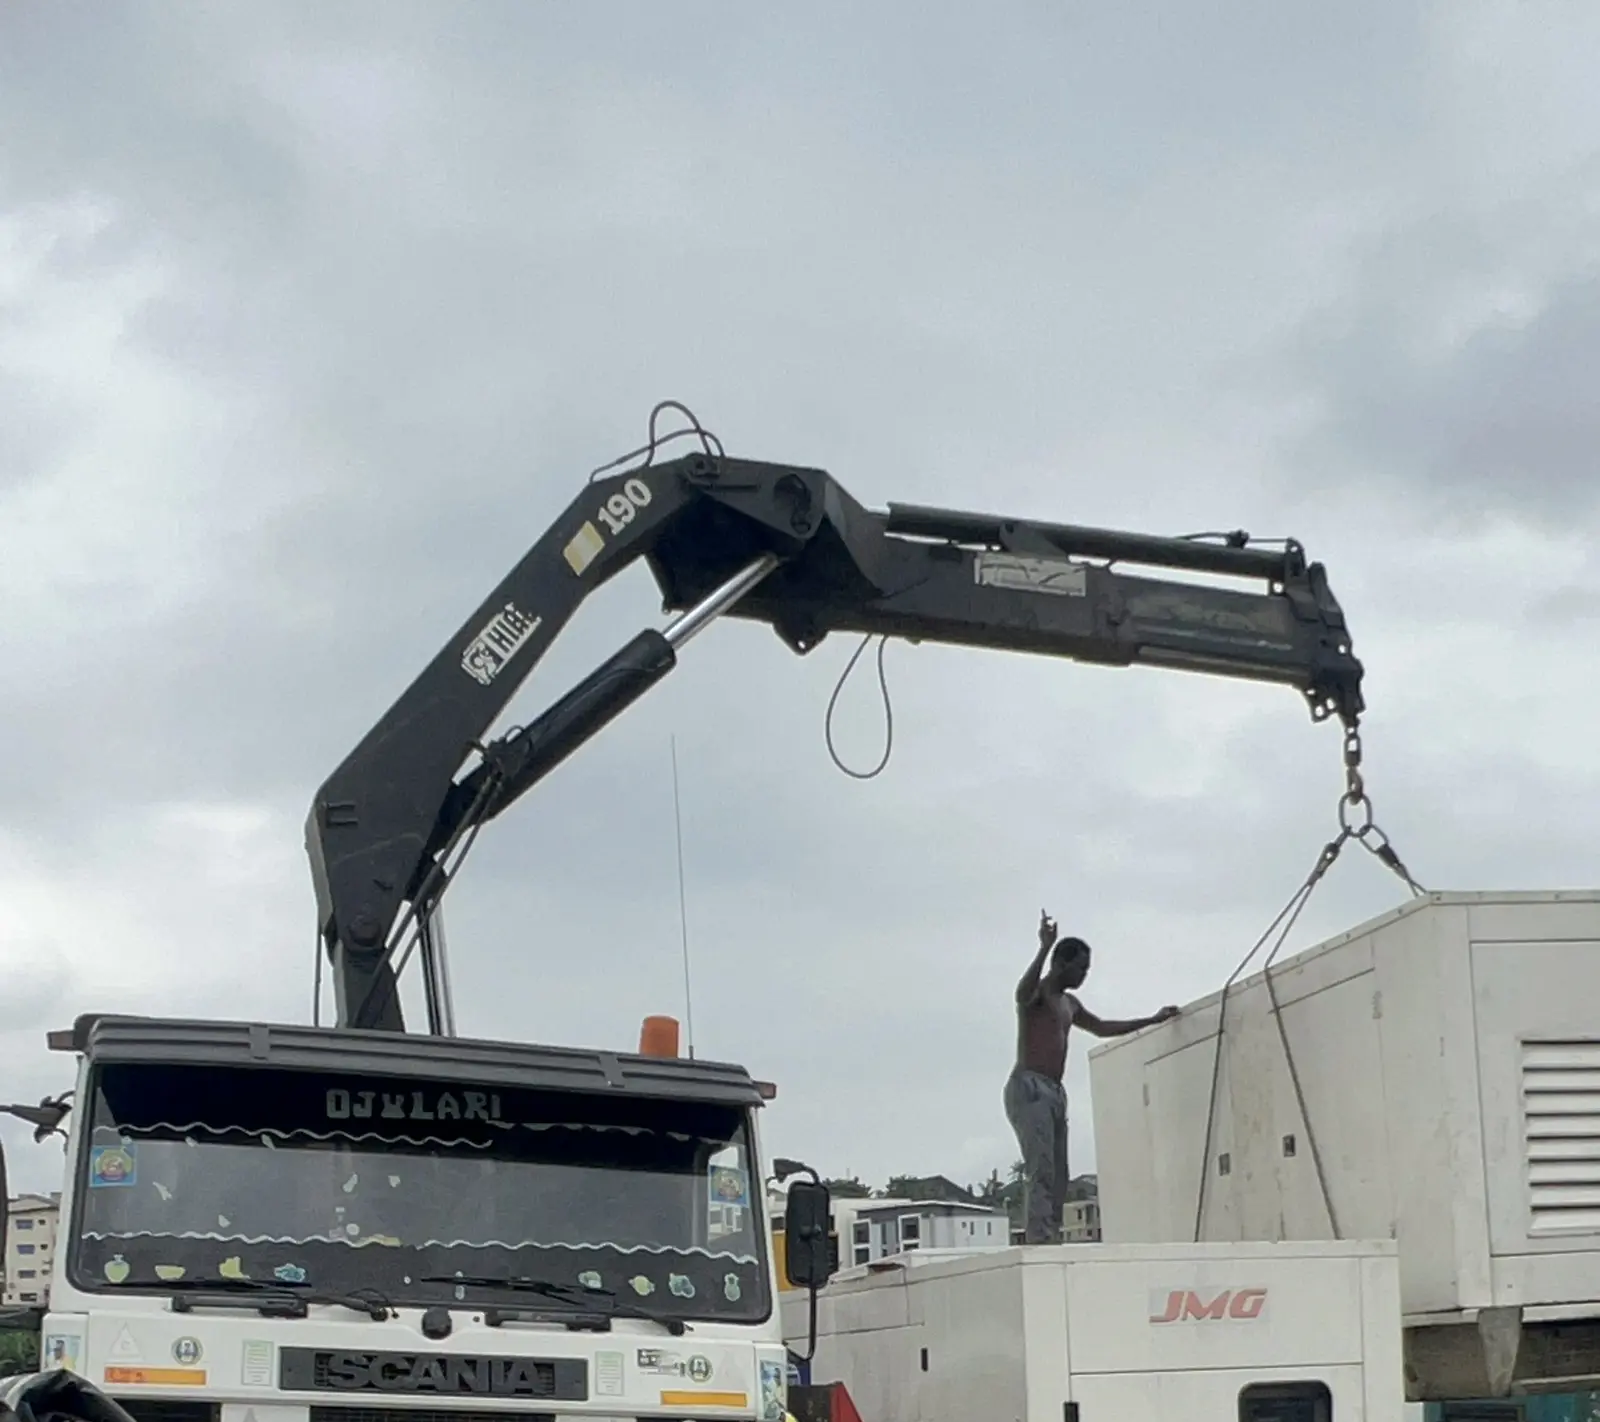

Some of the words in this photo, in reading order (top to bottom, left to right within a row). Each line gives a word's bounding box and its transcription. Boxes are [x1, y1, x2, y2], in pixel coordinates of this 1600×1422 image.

[598, 479, 652, 536] 190
[1149, 1288, 1267, 1323] JMG
[325, 1352, 544, 1395] SCANIA
